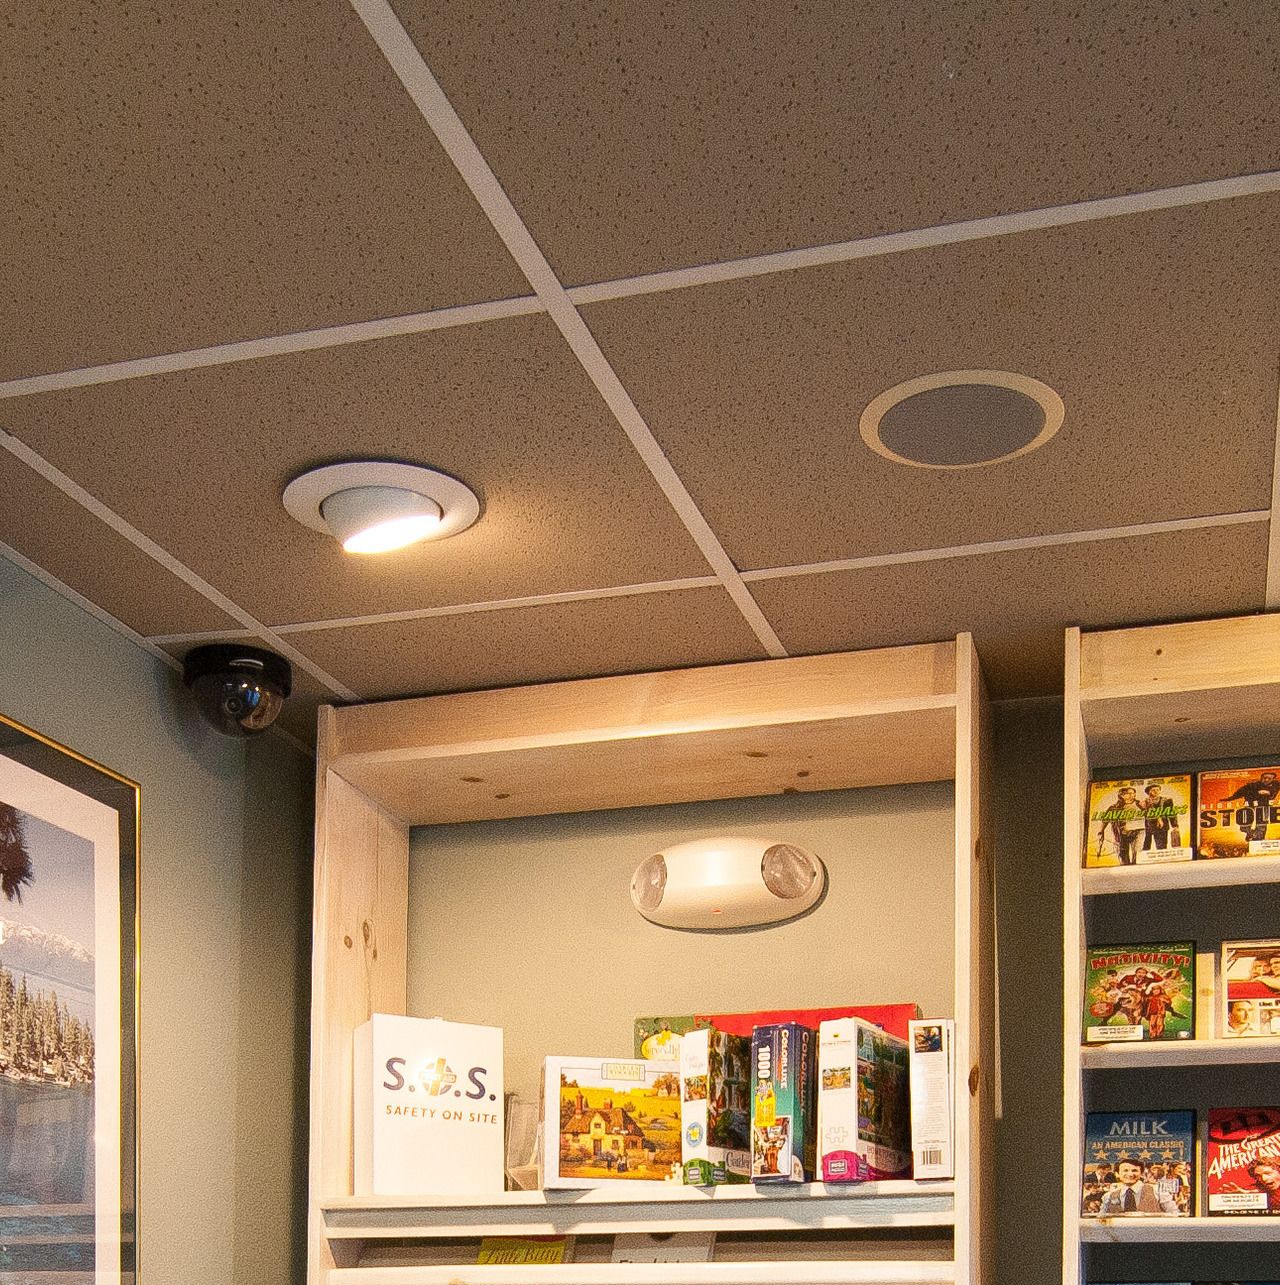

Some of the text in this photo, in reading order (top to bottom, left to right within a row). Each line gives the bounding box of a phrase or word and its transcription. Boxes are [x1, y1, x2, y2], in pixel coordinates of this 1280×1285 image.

[757, 1044, 771, 1079] 1000
[386, 1104, 498, 1125] SAFETY ON SITE
[1109, 1120, 1168, 1136] MILK
[1219, 1144, 1241, 1159] THE
